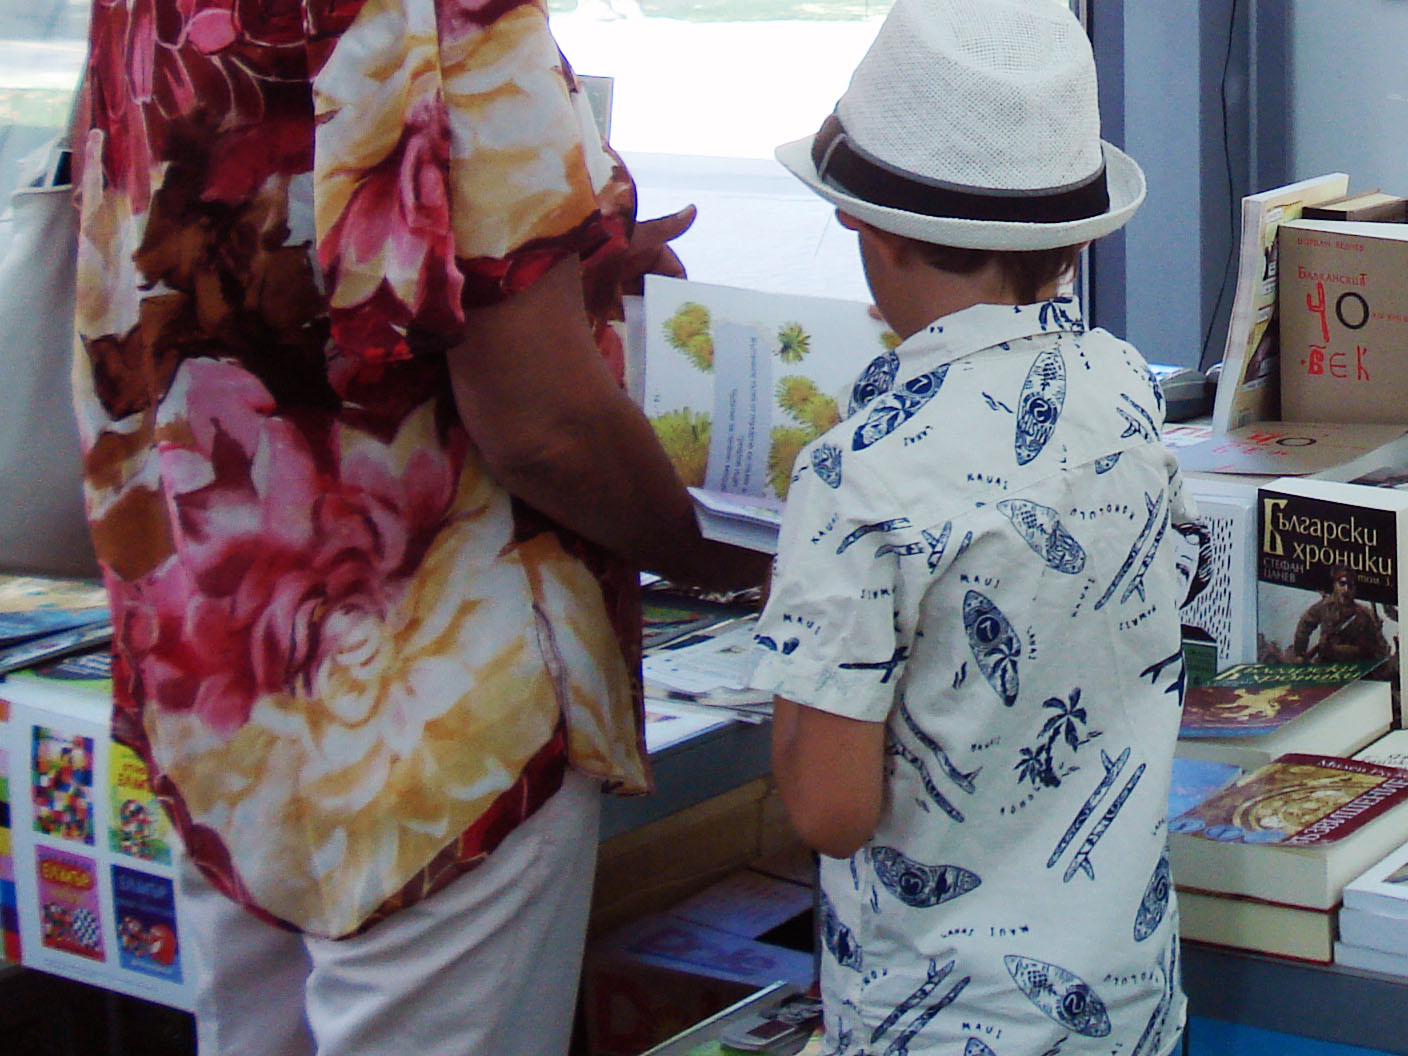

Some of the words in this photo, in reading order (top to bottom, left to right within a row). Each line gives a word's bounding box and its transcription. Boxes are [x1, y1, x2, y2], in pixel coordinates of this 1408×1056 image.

[967, 473, 1008, 490] KAUAI
[1263, 498, 1377, 556] Български
[1263, 558, 1304, 574] СТЕФАН
[1293, 541, 1392, 576] хроники
[960, 574, 1000, 589] MAUI
[1263, 569, 1296, 583] ЦАНЕВ
[783, 613, 821, 636] MAUI
[962, 1021, 1003, 1039] MAUI
